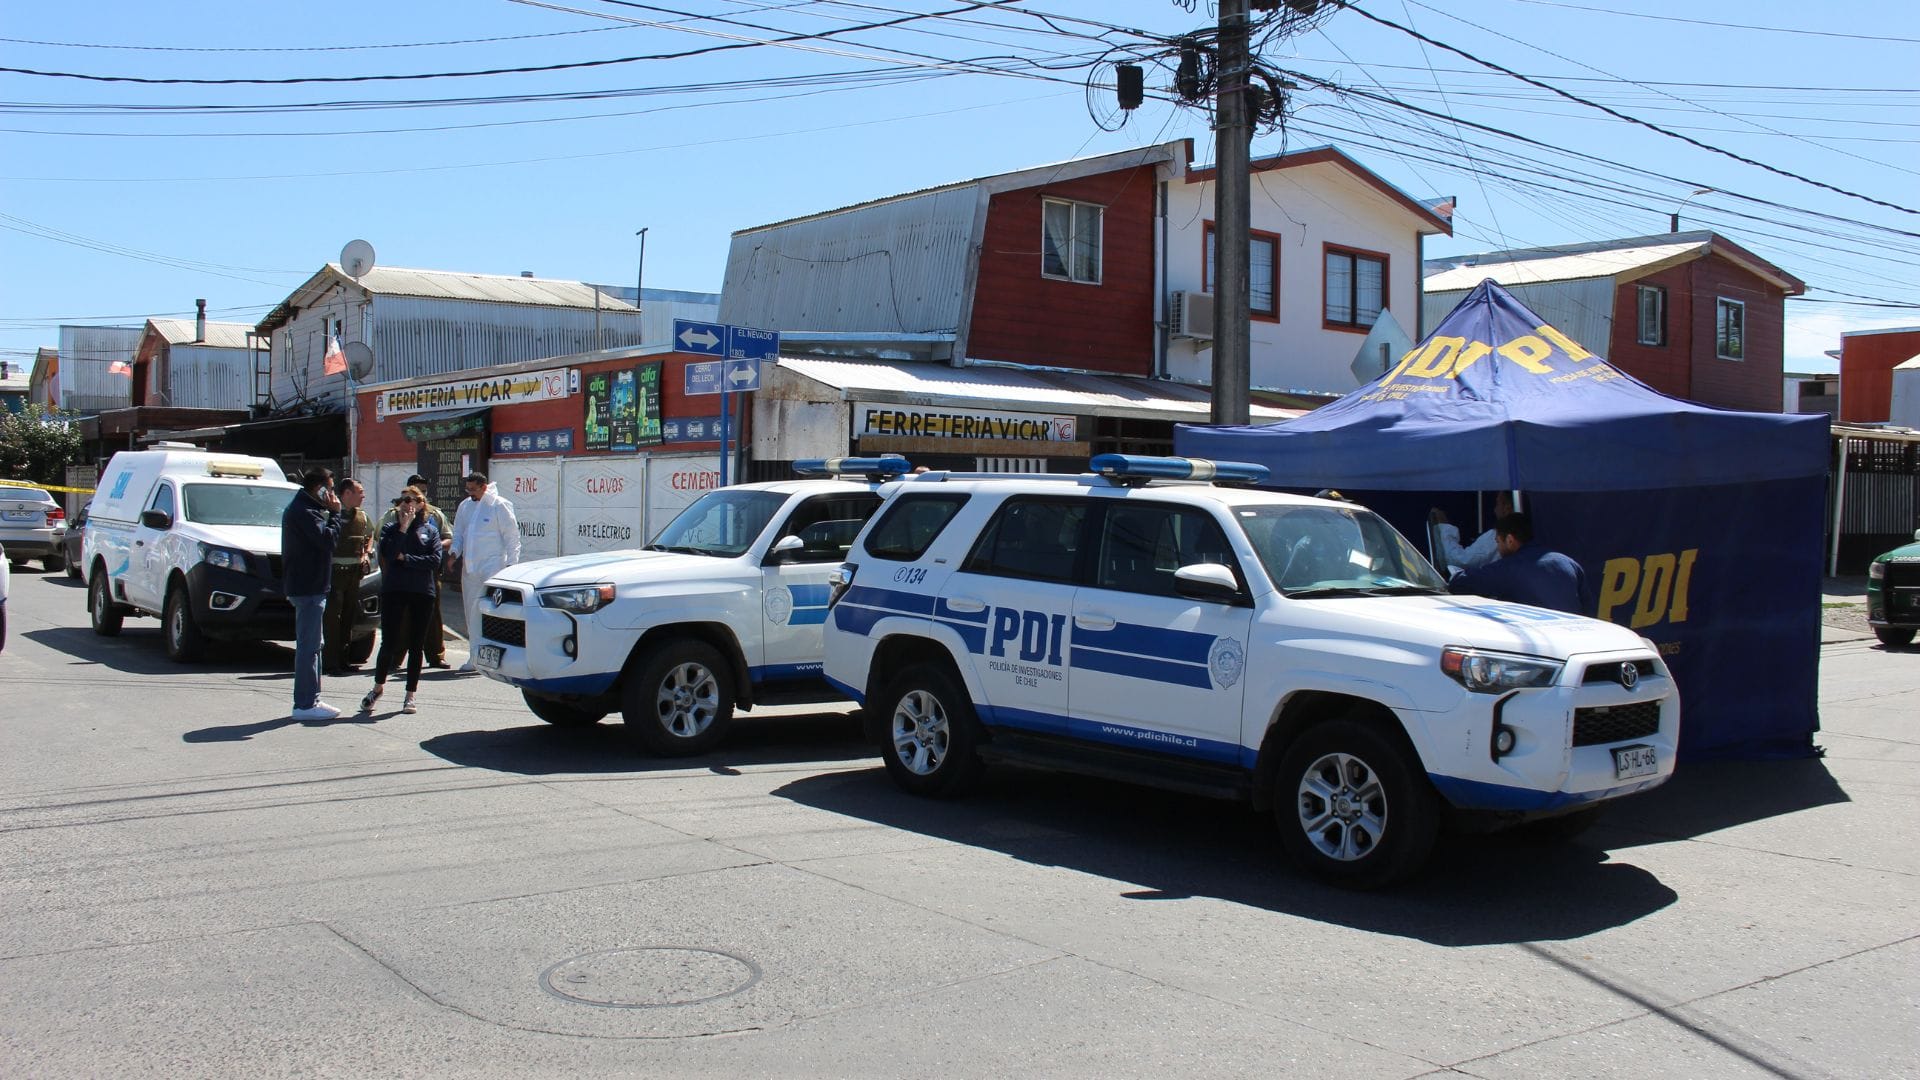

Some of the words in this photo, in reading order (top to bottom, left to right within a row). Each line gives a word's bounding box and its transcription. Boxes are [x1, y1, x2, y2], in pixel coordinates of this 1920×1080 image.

[738, 329, 745, 337] EL
[747, 330, 773, 341] NEVADO
[731, 348, 745, 357] 1802
[695, 365, 711, 373] CERRO
[692, 375, 701, 383] DEL
[587, 478, 624, 493] CLAVOS
[672, 471, 721, 490] CEMENT
[592, 525, 631, 540] ELECTRICO
[1597, 548, 1698, 628] PDI
[990, 606, 1066, 667] PDI
[1011, 664, 1018, 674] DE
[1018, 665, 1063, 681] INVESTIGACIONES
[1015, 675, 1022, 685] DE
[1023, 676, 1038, 688] CHILE
[1102, 725, 1197, 747] www.pdichile.cl
